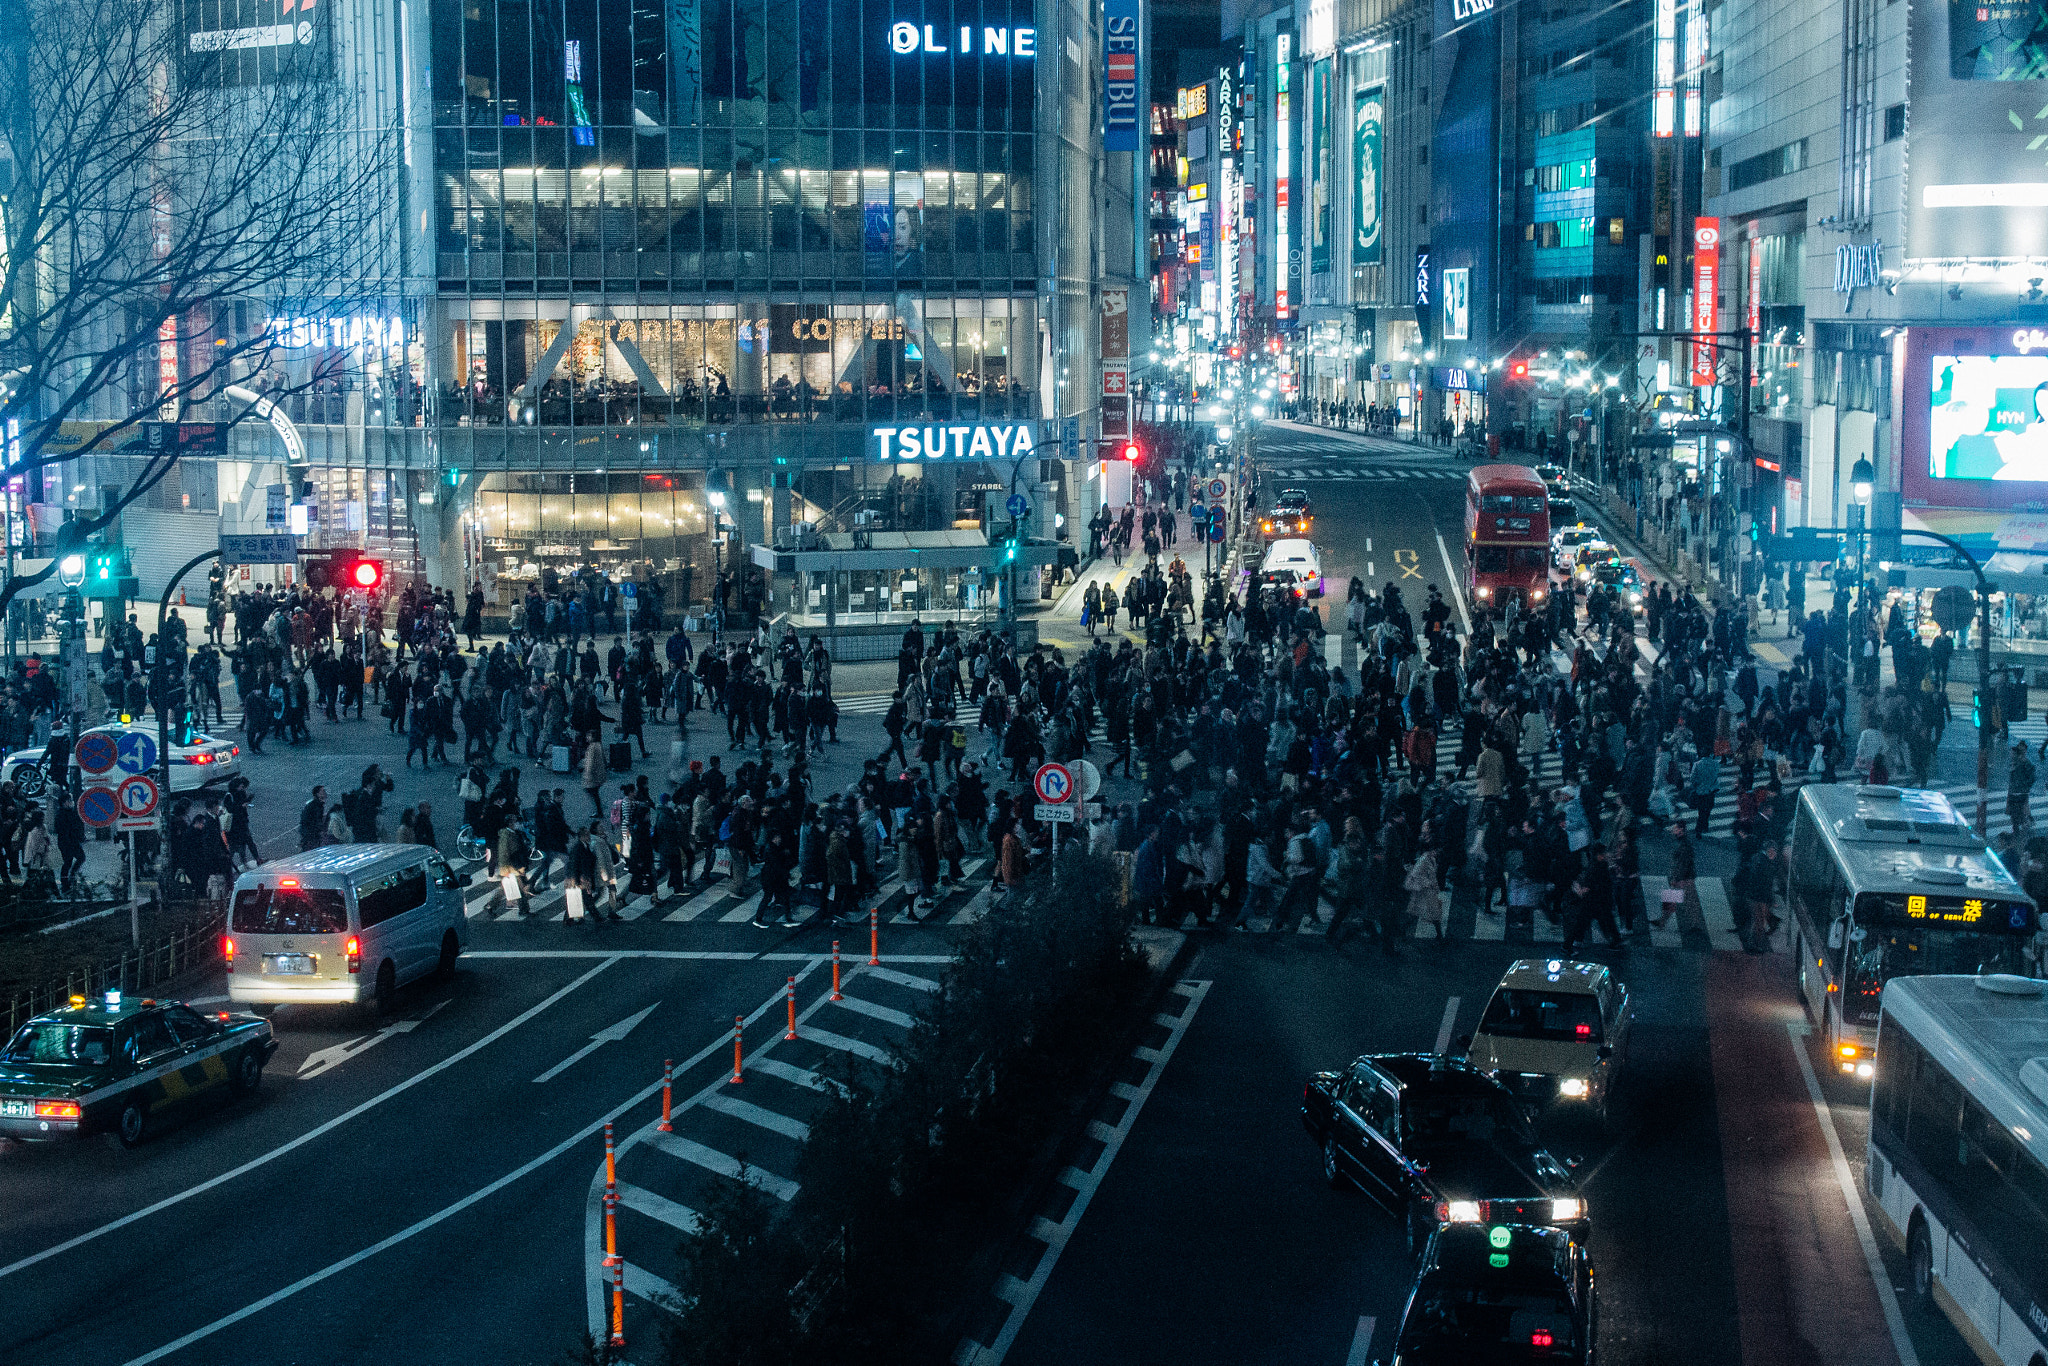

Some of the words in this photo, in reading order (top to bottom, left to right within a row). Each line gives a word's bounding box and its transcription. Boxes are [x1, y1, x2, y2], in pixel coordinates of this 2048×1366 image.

[1108, 15, 1136, 125] SEIBU
[1219, 67, 1232, 152] KARAOKE
[1356, 101, 1382, 131] JAMESON
[1416, 254, 1429, 305] ZARA
[268, 316, 403, 347] TSUTAYA
[578, 318, 773, 342] STARBUCKS
[792, 318, 904, 342] COFFEE
[1106, 373, 1124, 392] 本
[1448, 368, 1468, 389] ZARA
[873, 425, 1035, 460] TSUTAYA
[228, 538, 291, 552] 渋谷駅前
[504, 530, 562, 539] STARBUCKS
[239, 552, 268, 562] Shibuya
[1037, 808, 1072, 820] ここから
[1943, 914, 1977, 922] SERVICE
[2029, 1301, 2048, 1334] KEIO
